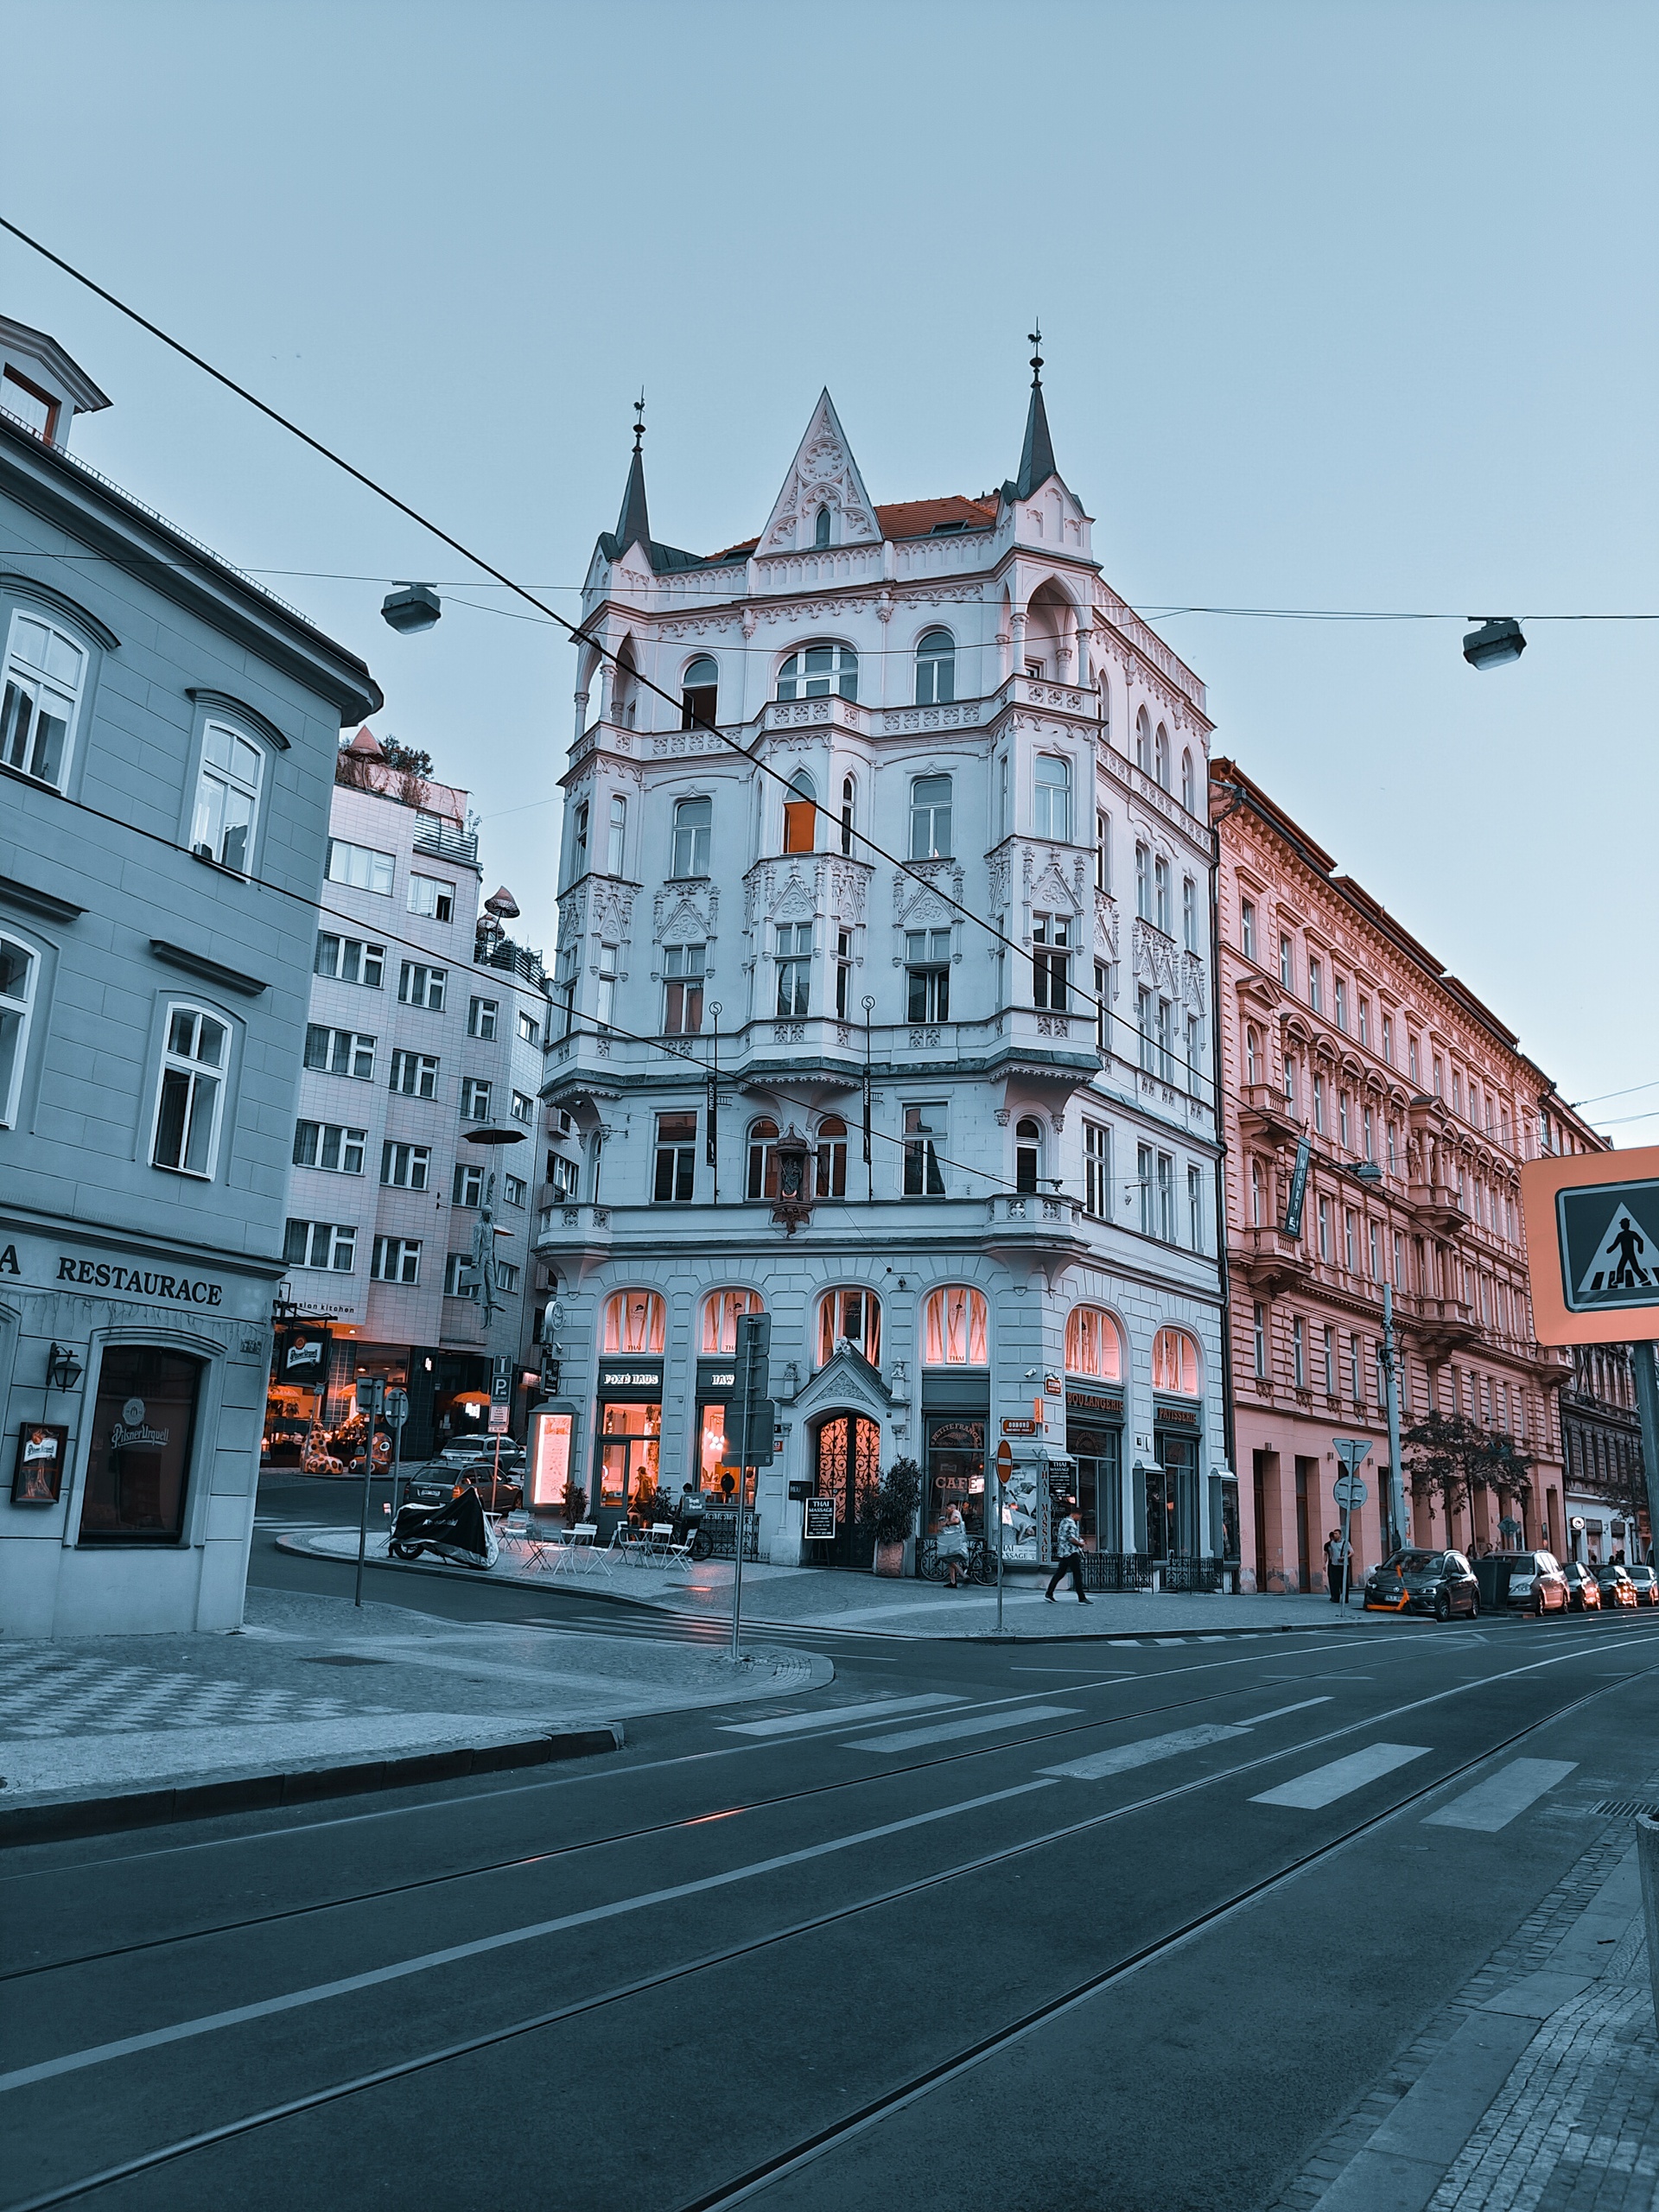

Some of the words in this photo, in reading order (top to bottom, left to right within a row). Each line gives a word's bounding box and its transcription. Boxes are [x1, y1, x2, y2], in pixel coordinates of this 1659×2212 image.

[56, 1256, 223, 1306] RESTAURACE
[321, 1303, 355, 1313] kitchen
[495, 1378, 507, 1395] P
[604, 1372, 631, 1385] POKÉ
[632, 1374, 658, 1385] HAUS
[711, 1374, 736, 1386] HAW
[1066, 1392, 1123, 1412] BOULANGERIE
[1159, 1408, 1197, 1423] PATISSERIE
[111, 1423, 141, 1449] Pilsner
[142, 1424, 170, 1446] Urquell
[931, 1424, 955, 1441] PETITE
[955, 1423, 982, 1442] FRANCE
